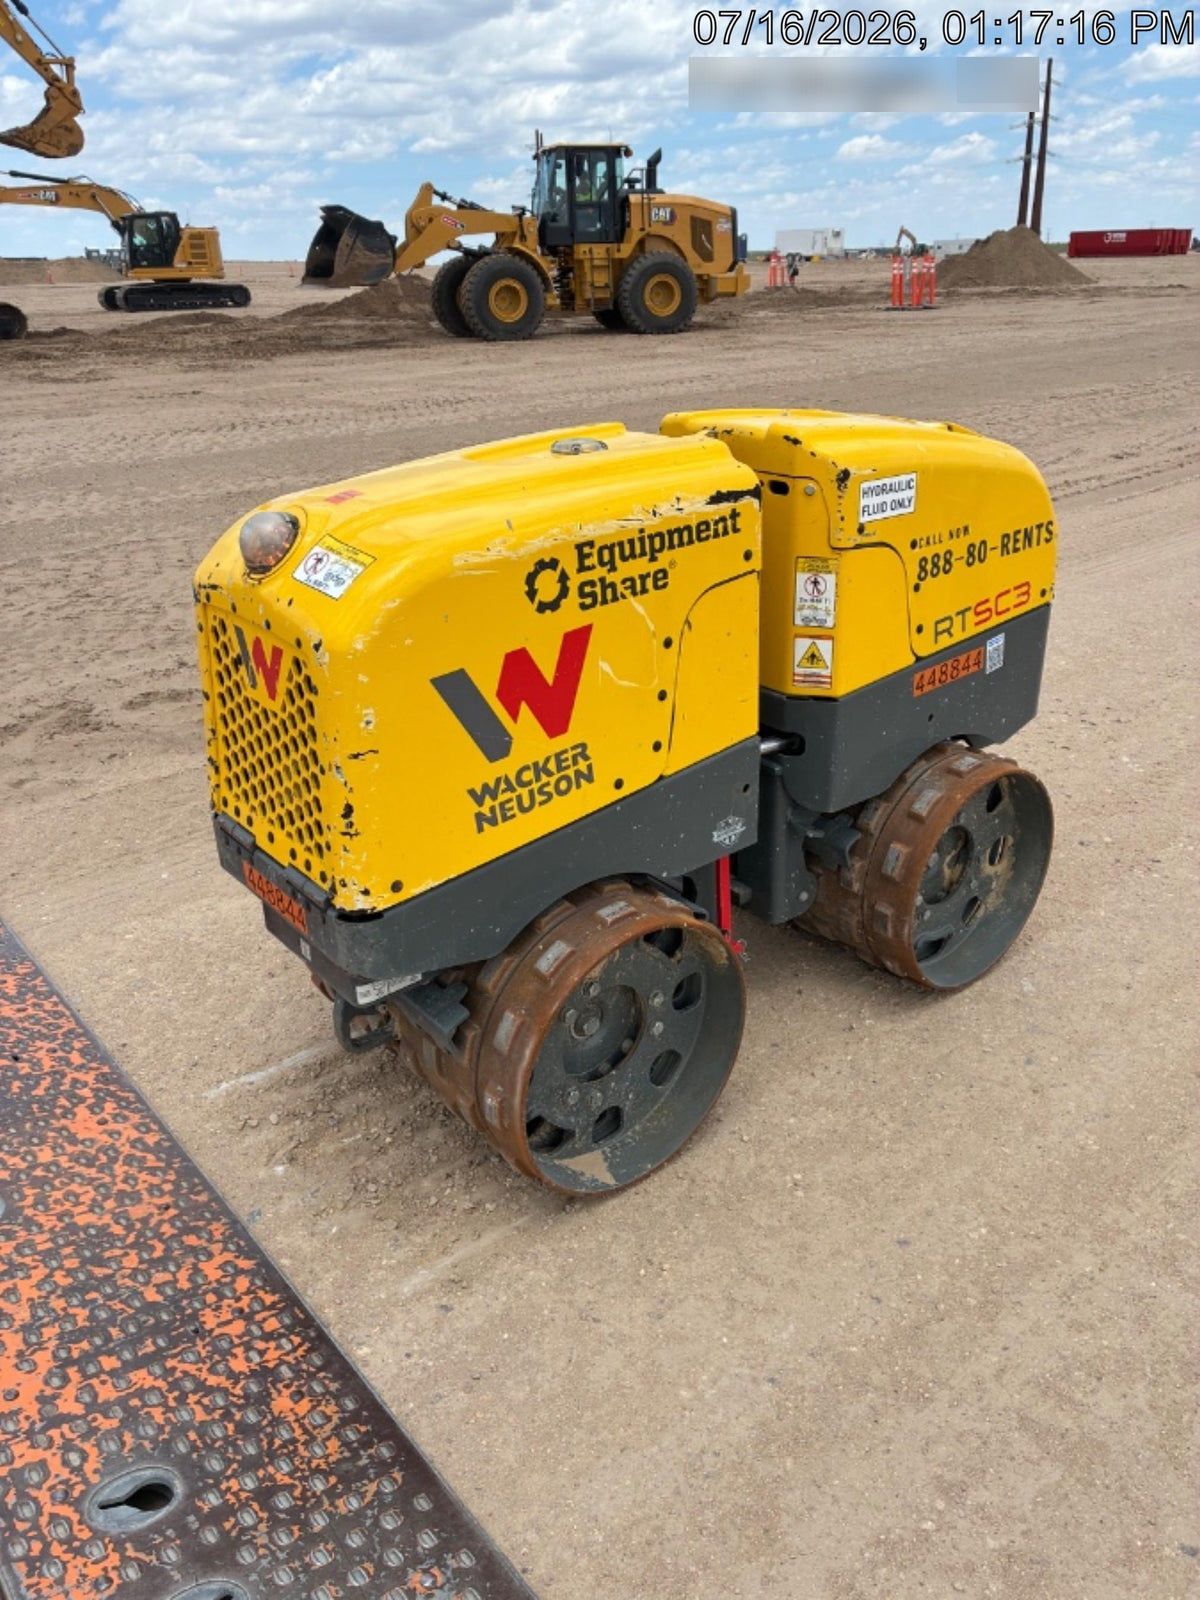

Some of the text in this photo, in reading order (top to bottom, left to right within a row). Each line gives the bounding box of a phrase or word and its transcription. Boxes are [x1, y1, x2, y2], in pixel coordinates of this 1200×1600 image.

[651, 207, 671, 222] CAT
[862, 478, 915, 499] HYDRAULIC
[862, 496, 914, 517] FLUID ONLY
[575, 508, 741, 575] Equipment
[917, 520, 1054, 582] 888-80-RENTS
[918, 532, 944, 549] CALL
[578, 566, 670, 611] Share
[934, 581, 1031, 644] RTSC3
[914, 649, 983, 692] 448844
[467, 742, 591, 808] WACKER
[474, 763, 595, 834] NEUSON
[248, 867, 307, 932] 448844
